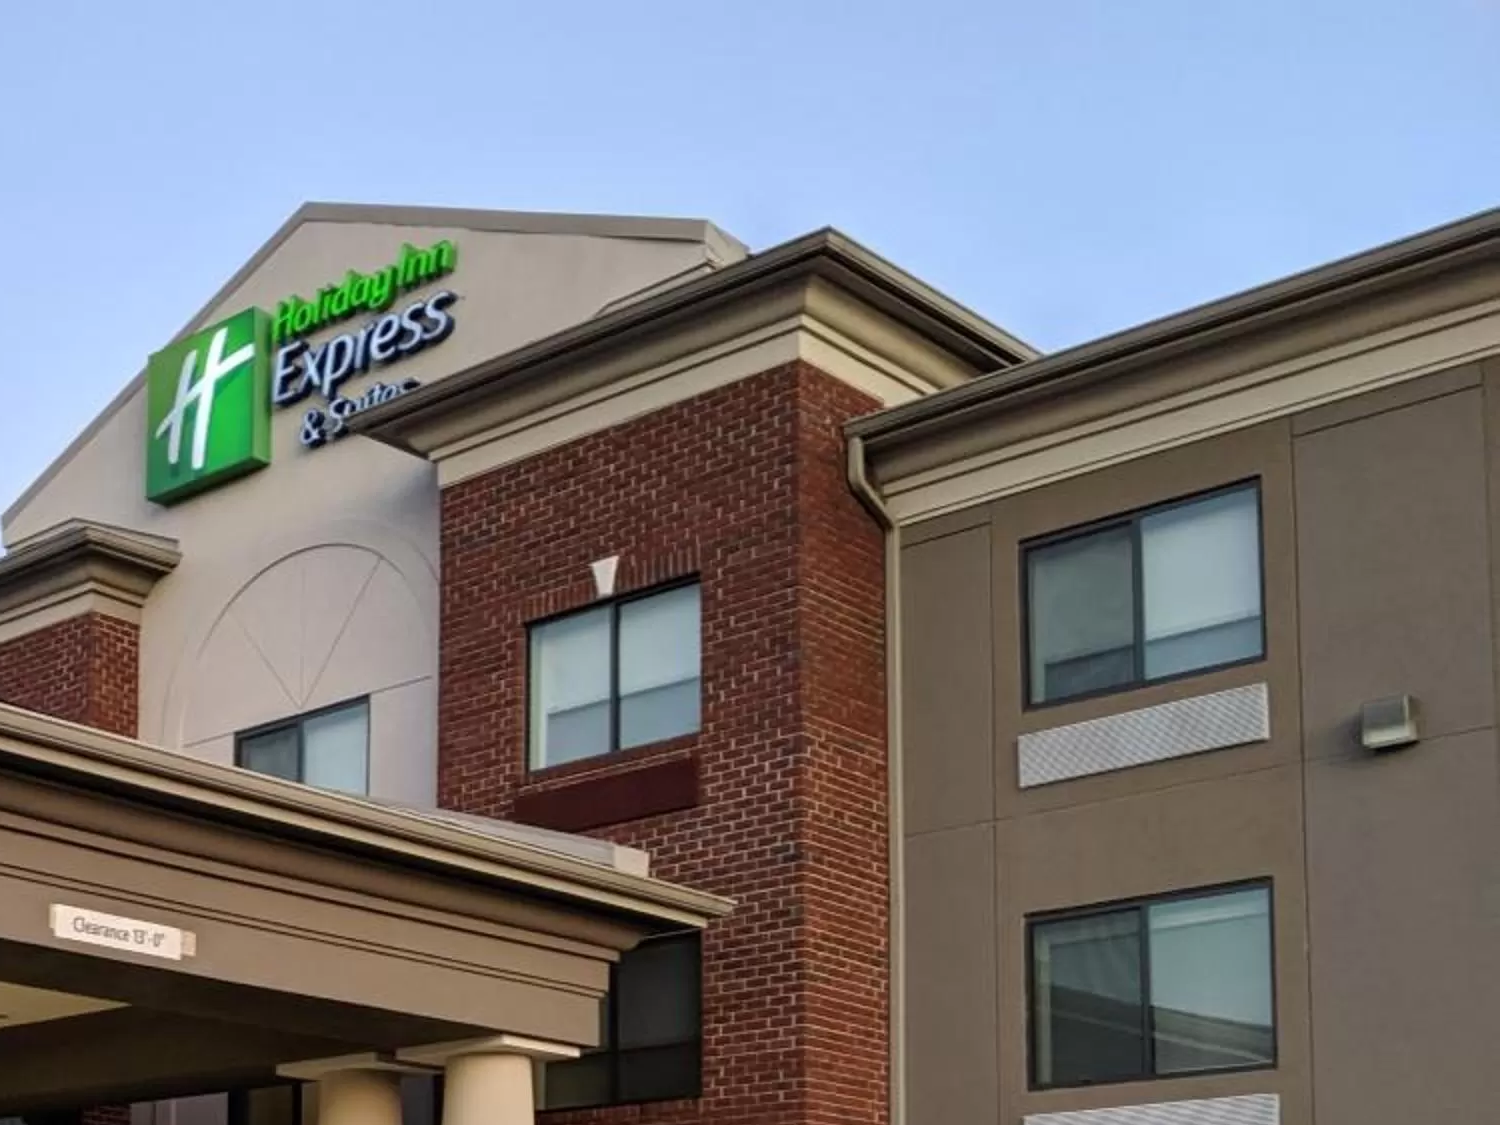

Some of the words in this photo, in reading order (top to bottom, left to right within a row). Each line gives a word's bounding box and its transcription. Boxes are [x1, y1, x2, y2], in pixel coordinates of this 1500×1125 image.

[273, 266, 398, 342] Holiday
[396, 240, 457, 289] Inn
[272, 291, 457, 405] Express
[300, 408, 326, 448] &
